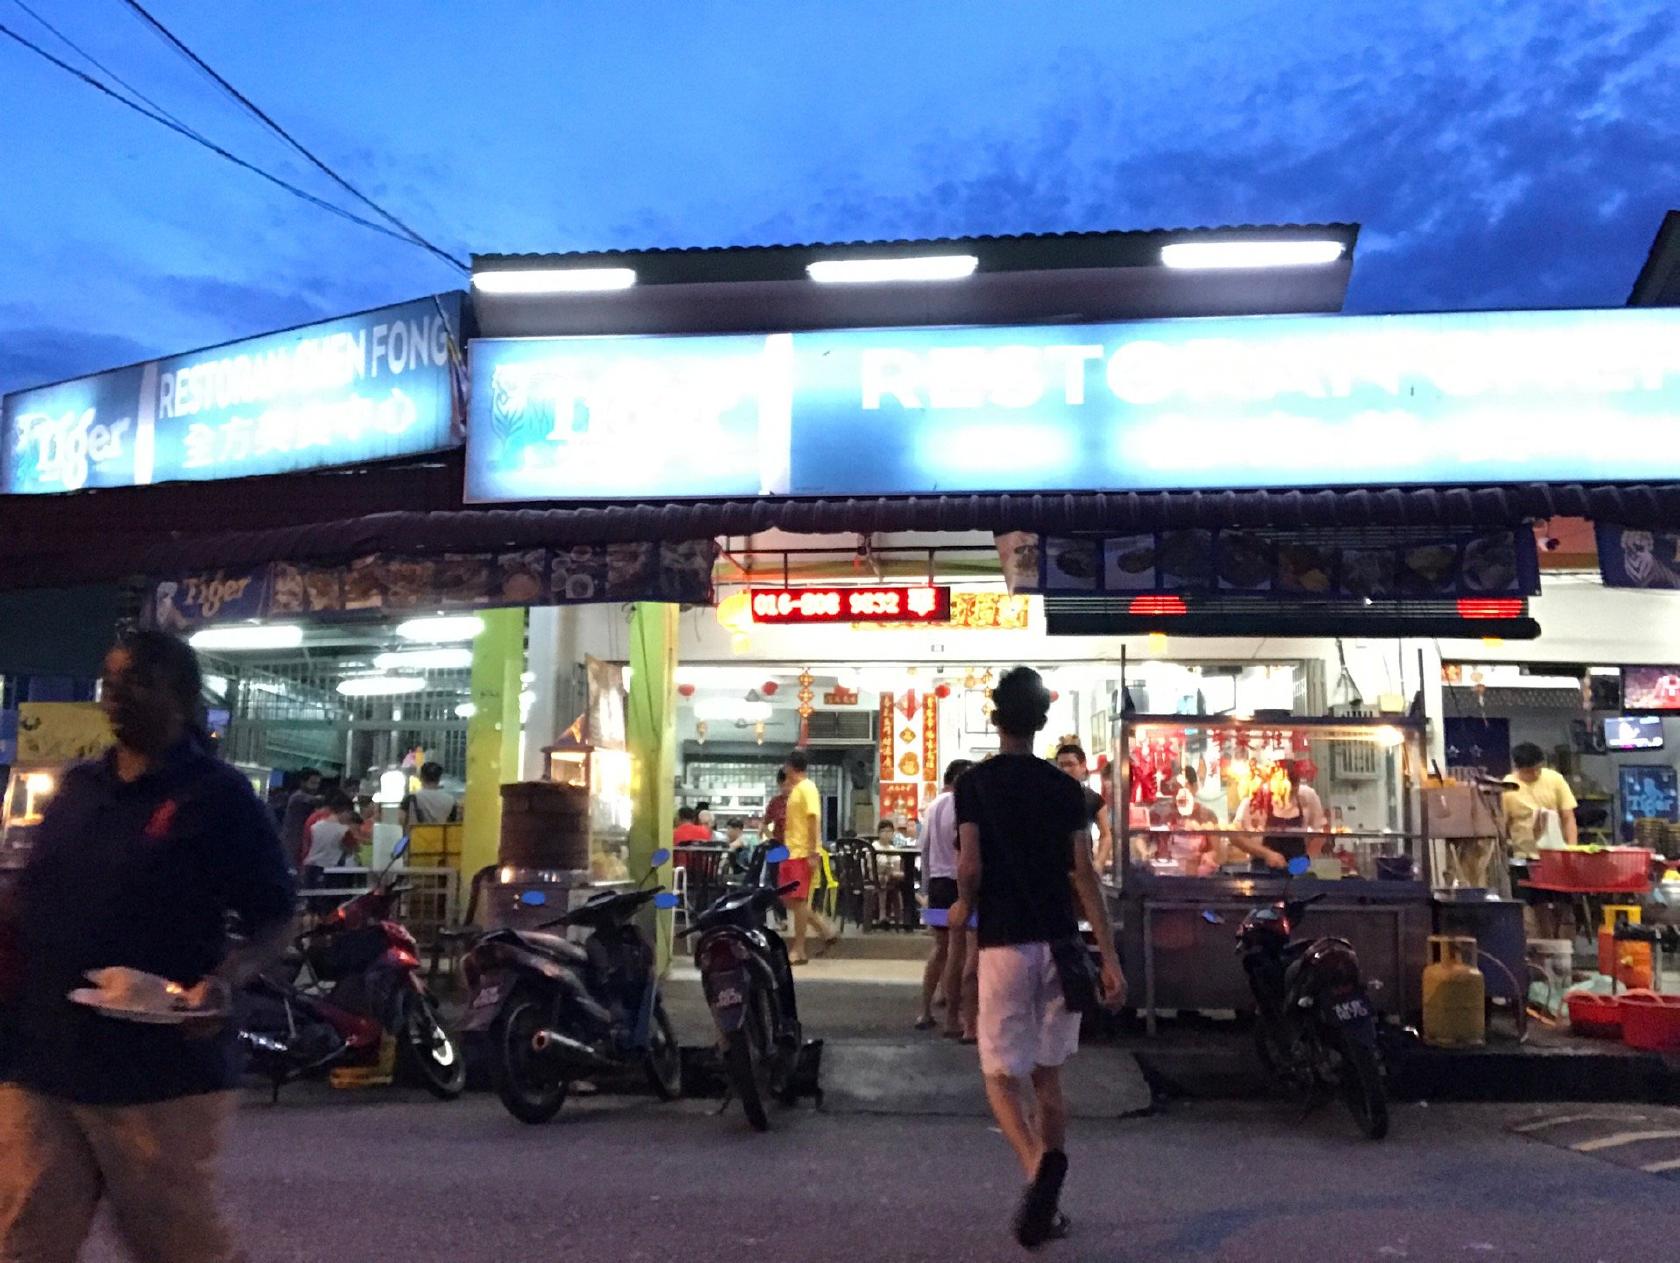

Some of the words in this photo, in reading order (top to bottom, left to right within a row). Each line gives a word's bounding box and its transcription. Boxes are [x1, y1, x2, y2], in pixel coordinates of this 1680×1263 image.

[371, 313, 448, 378] FONG
[28, 407, 131, 490] Tiger
[184, 576, 251, 617] Tiger
